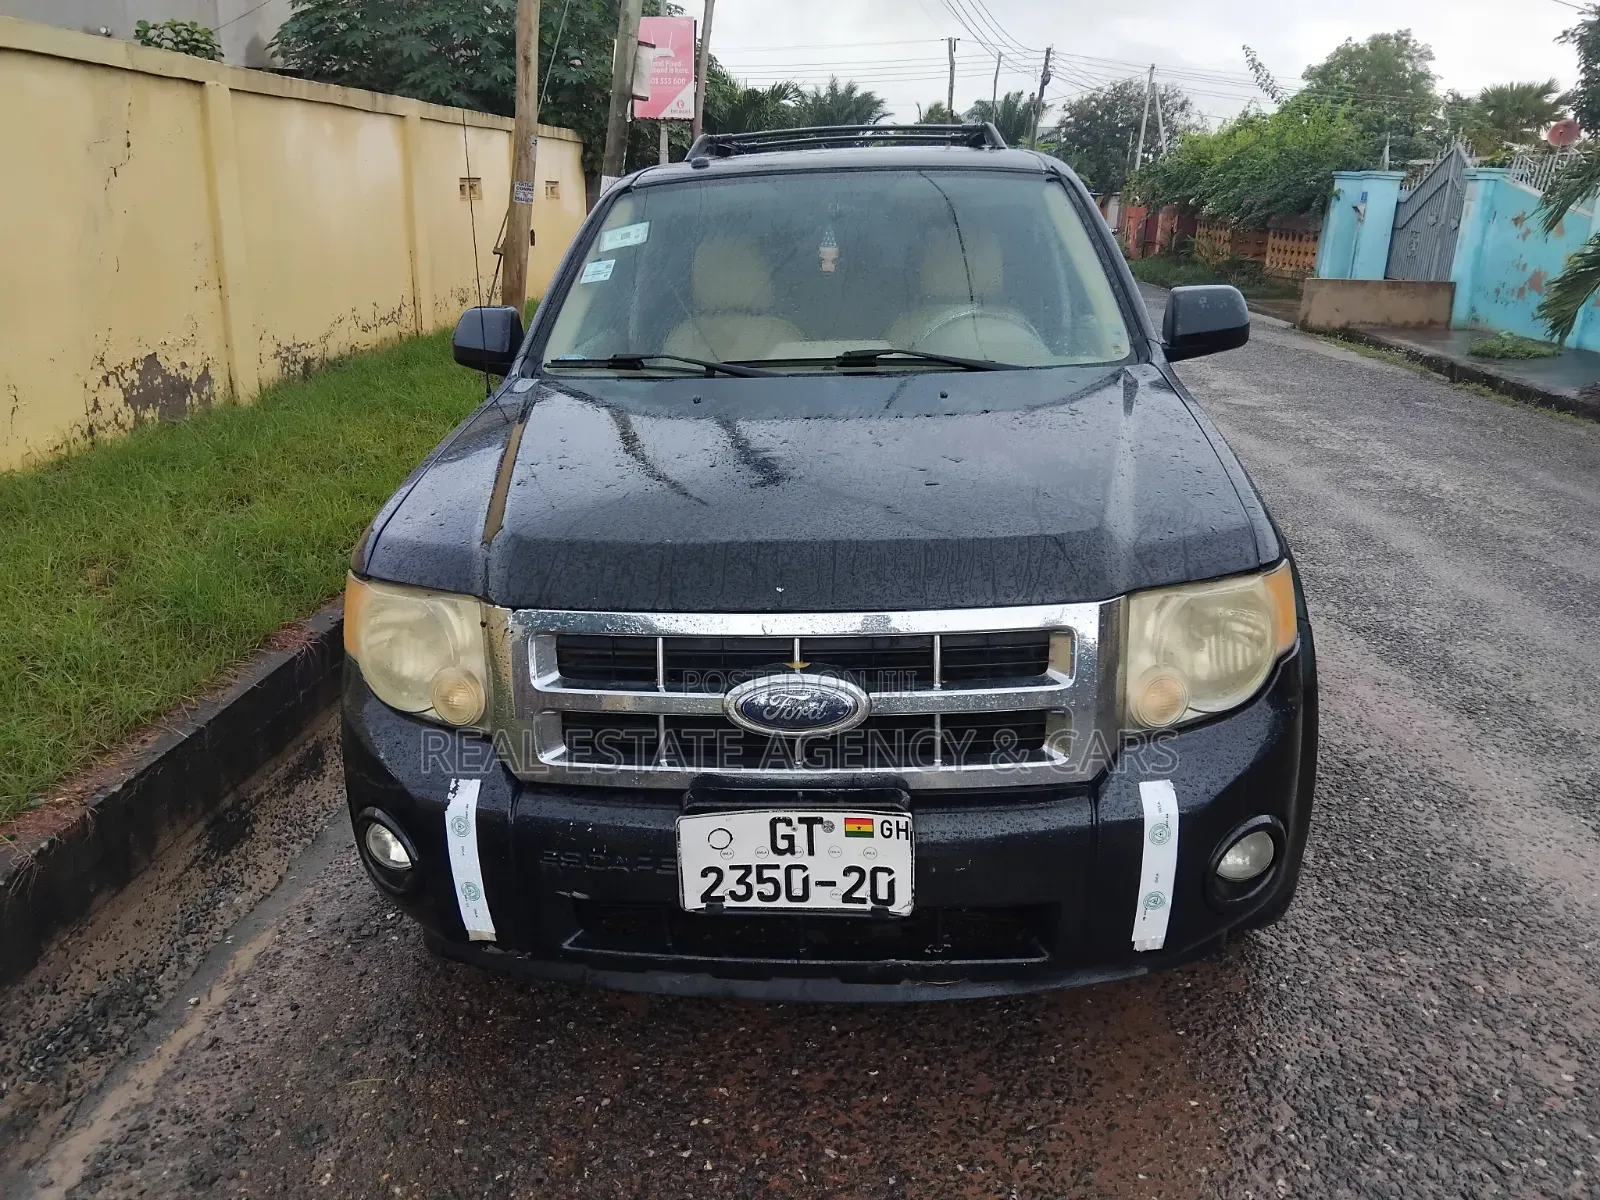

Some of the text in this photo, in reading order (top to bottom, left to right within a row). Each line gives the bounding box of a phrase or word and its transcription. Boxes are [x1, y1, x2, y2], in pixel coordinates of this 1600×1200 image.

[673, 77, 686, 85] 600
[762, 693, 828, 721] Ford
[769, 816, 824, 857] GT
[880, 819, 909, 841] GH
[700, 864, 896, 907] 2350-20
